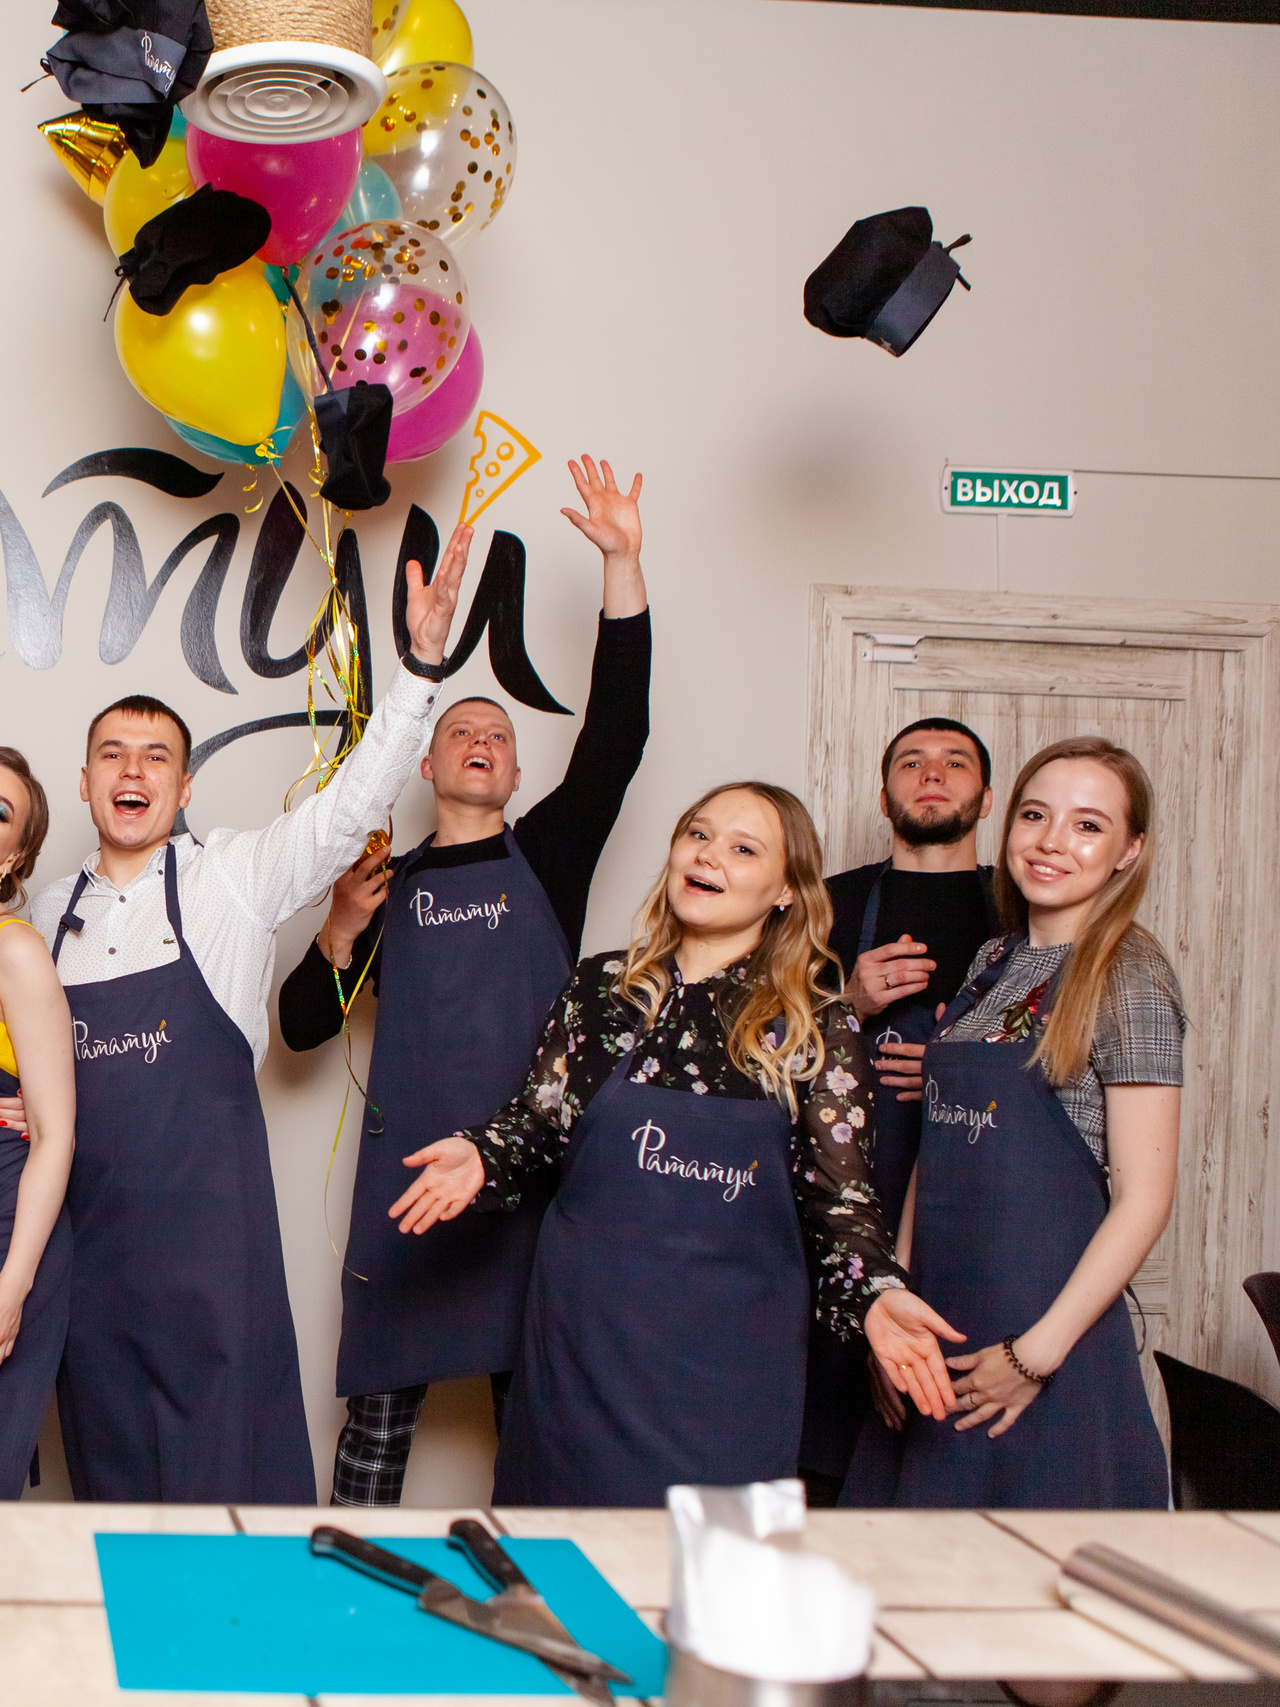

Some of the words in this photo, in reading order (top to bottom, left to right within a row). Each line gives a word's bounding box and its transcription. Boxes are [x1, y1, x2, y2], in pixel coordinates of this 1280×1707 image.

[956, 478, 1062, 507] ВЫХОД
[409, 887, 510, 930] Рататуй
[71, 1016, 172, 1064] Рататуй
[925, 1074, 998, 1144] Рататуй
[631, 1119, 758, 1202] Рататуй
